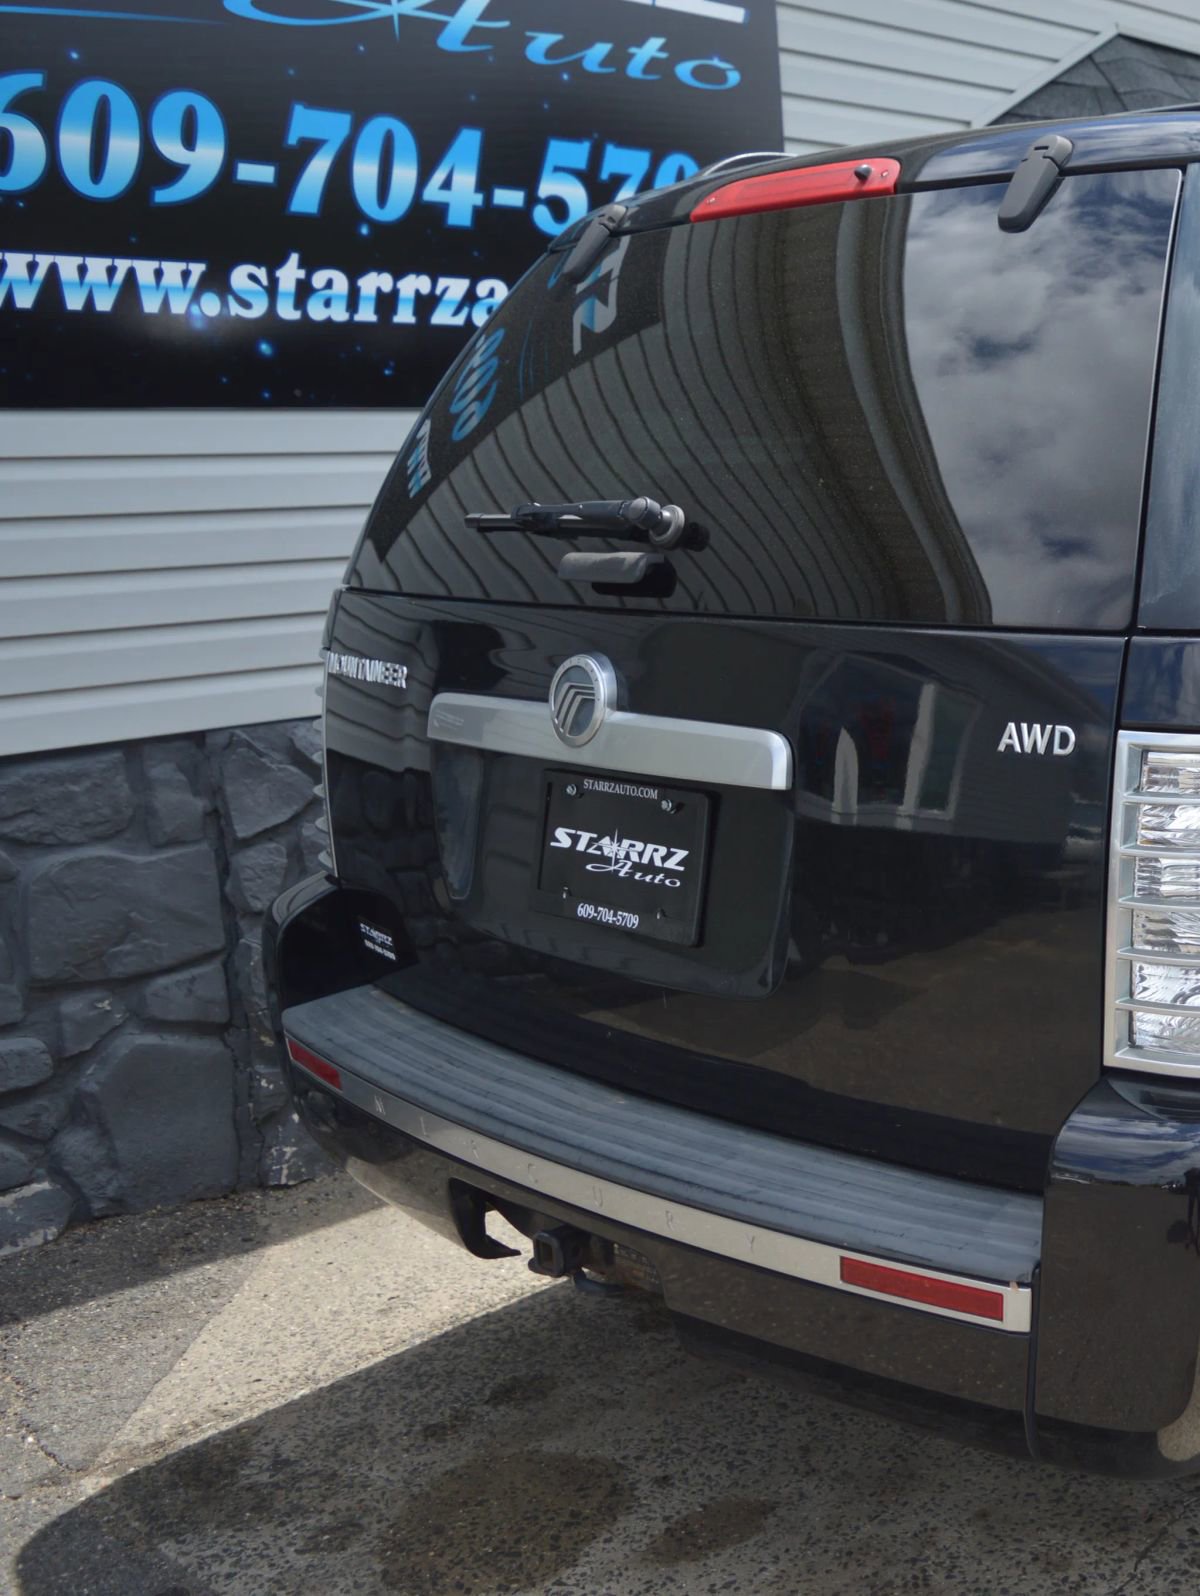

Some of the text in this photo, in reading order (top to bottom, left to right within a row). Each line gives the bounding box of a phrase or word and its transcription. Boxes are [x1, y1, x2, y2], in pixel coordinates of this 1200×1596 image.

[997, 722, 1076, 756] AWD
[583, 778, 658, 800] STARRZAUTO.COM
[550, 827, 690, 872] STARRZ
[585, 860, 681, 888] Auto
[577, 903, 640, 929] 609-704-5709
